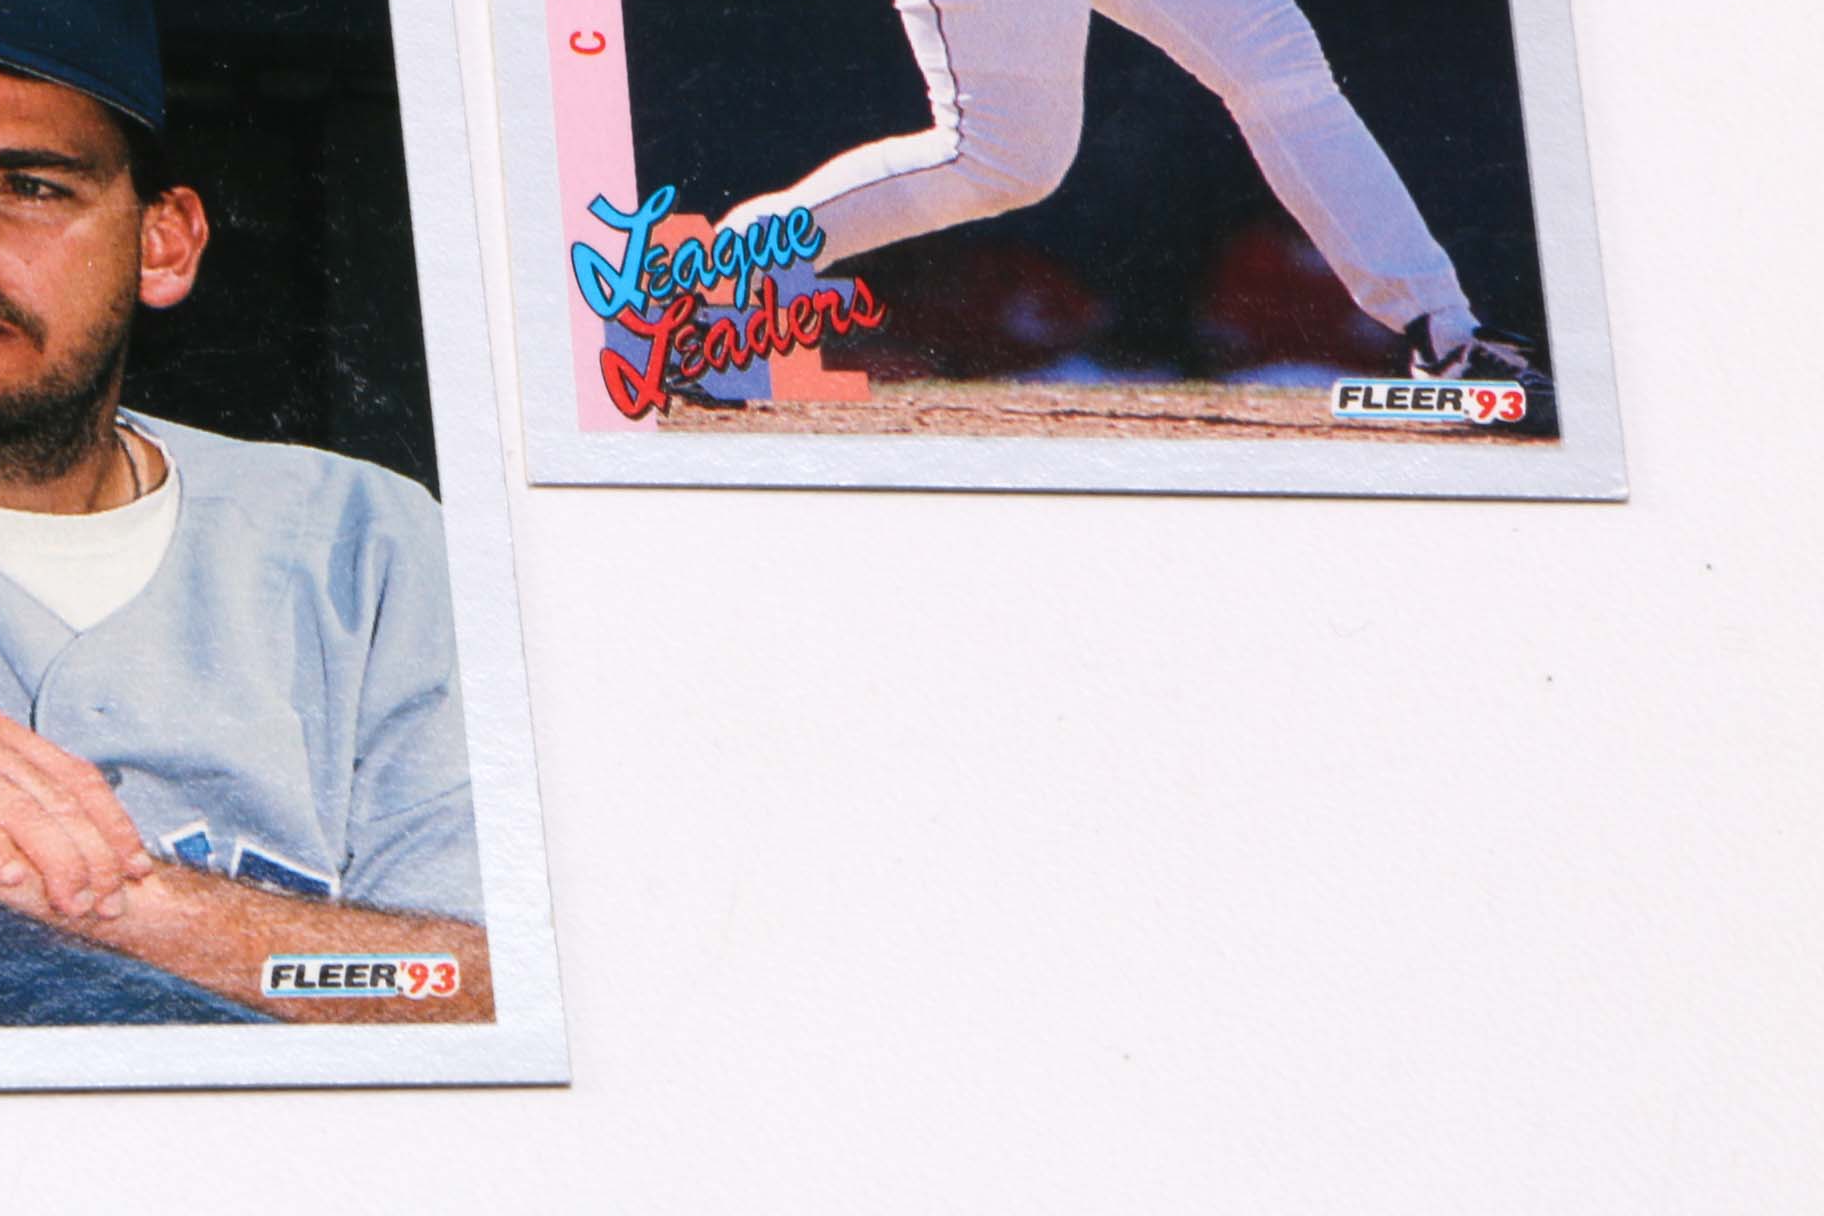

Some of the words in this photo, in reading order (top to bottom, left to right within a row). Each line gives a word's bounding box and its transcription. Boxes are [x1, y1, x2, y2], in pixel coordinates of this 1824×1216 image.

[571, 184, 828, 320] League
[599, 275, 887, 421] Leaders
[1338, 386, 1463, 412] FLEER
[270, 963, 397, 990] FLEER
